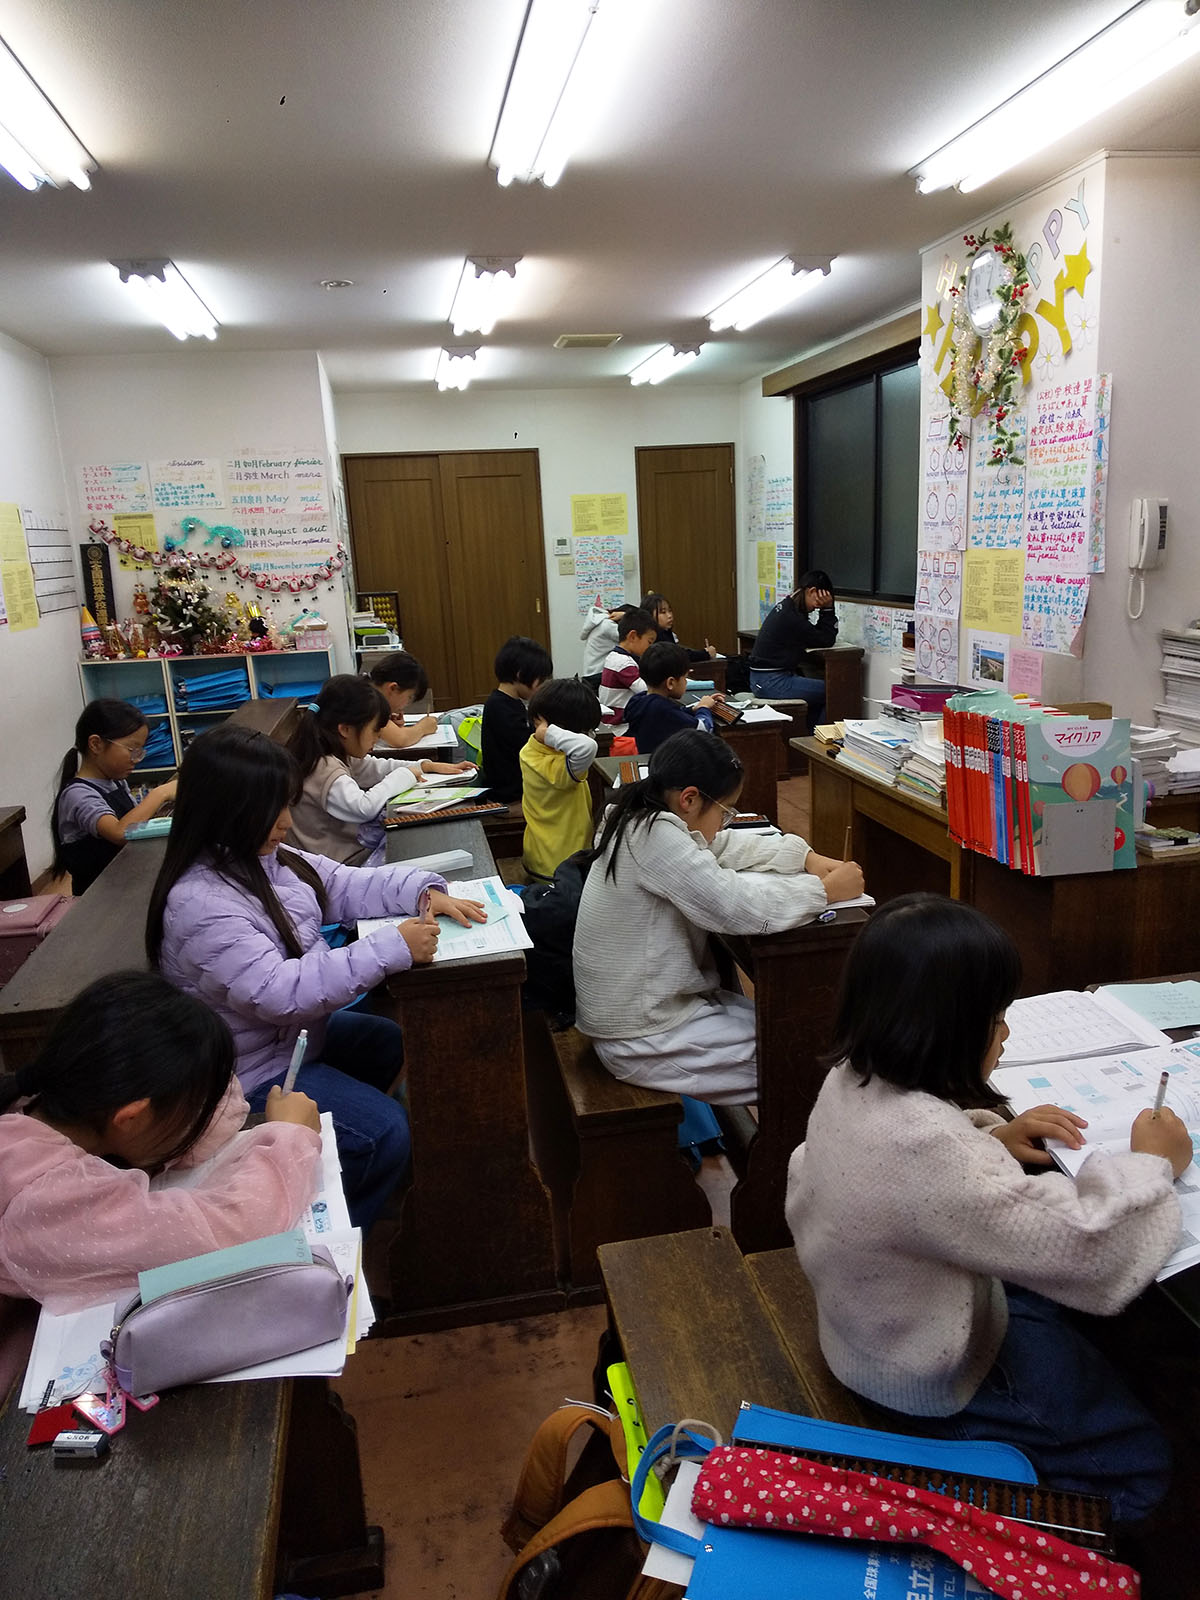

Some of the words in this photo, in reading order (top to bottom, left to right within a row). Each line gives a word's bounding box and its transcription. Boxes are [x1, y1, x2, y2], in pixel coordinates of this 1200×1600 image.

[258, 460, 291, 468] February
[260, 471, 289, 480] March
[267, 495, 289, 504] May
[267, 506, 286, 514] June
[267, 527, 297, 537] August
[267, 539, 301, 548] September
[269, 562, 304, 570] November
[1054, 731, 1102, 744] マイクリア
[943, 1576, 956, 1598] TEL
